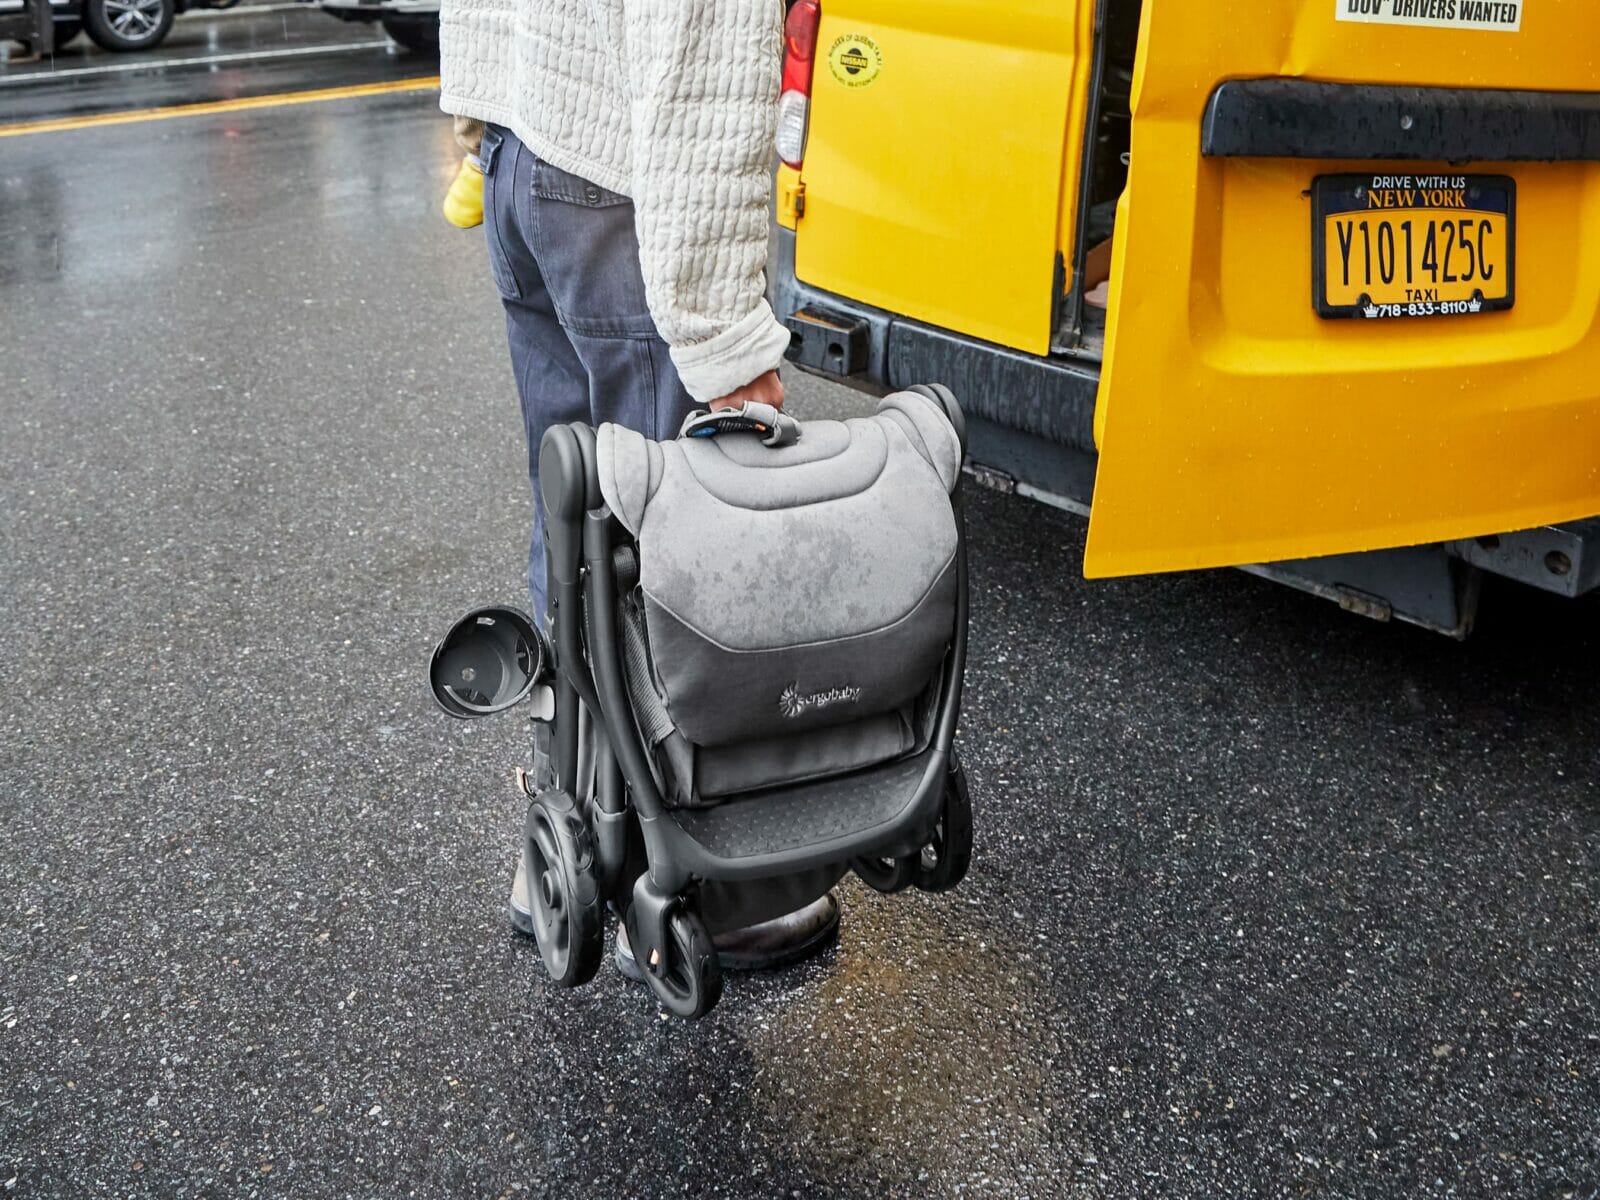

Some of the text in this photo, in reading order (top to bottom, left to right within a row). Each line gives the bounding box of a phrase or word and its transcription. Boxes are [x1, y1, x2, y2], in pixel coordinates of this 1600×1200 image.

[1459, 0, 1518, 24] WANTED
[1372, 176, 1466, 189] DRIVE WITH US
[1367, 190, 1466, 208] NEW YORK
[1336, 219, 1494, 286] Y101425C
[1405, 289, 1438, 302] TAXI
[1378, 301, 1468, 317] 718-833-8110
[805, 686, 860, 707] ergobaby
